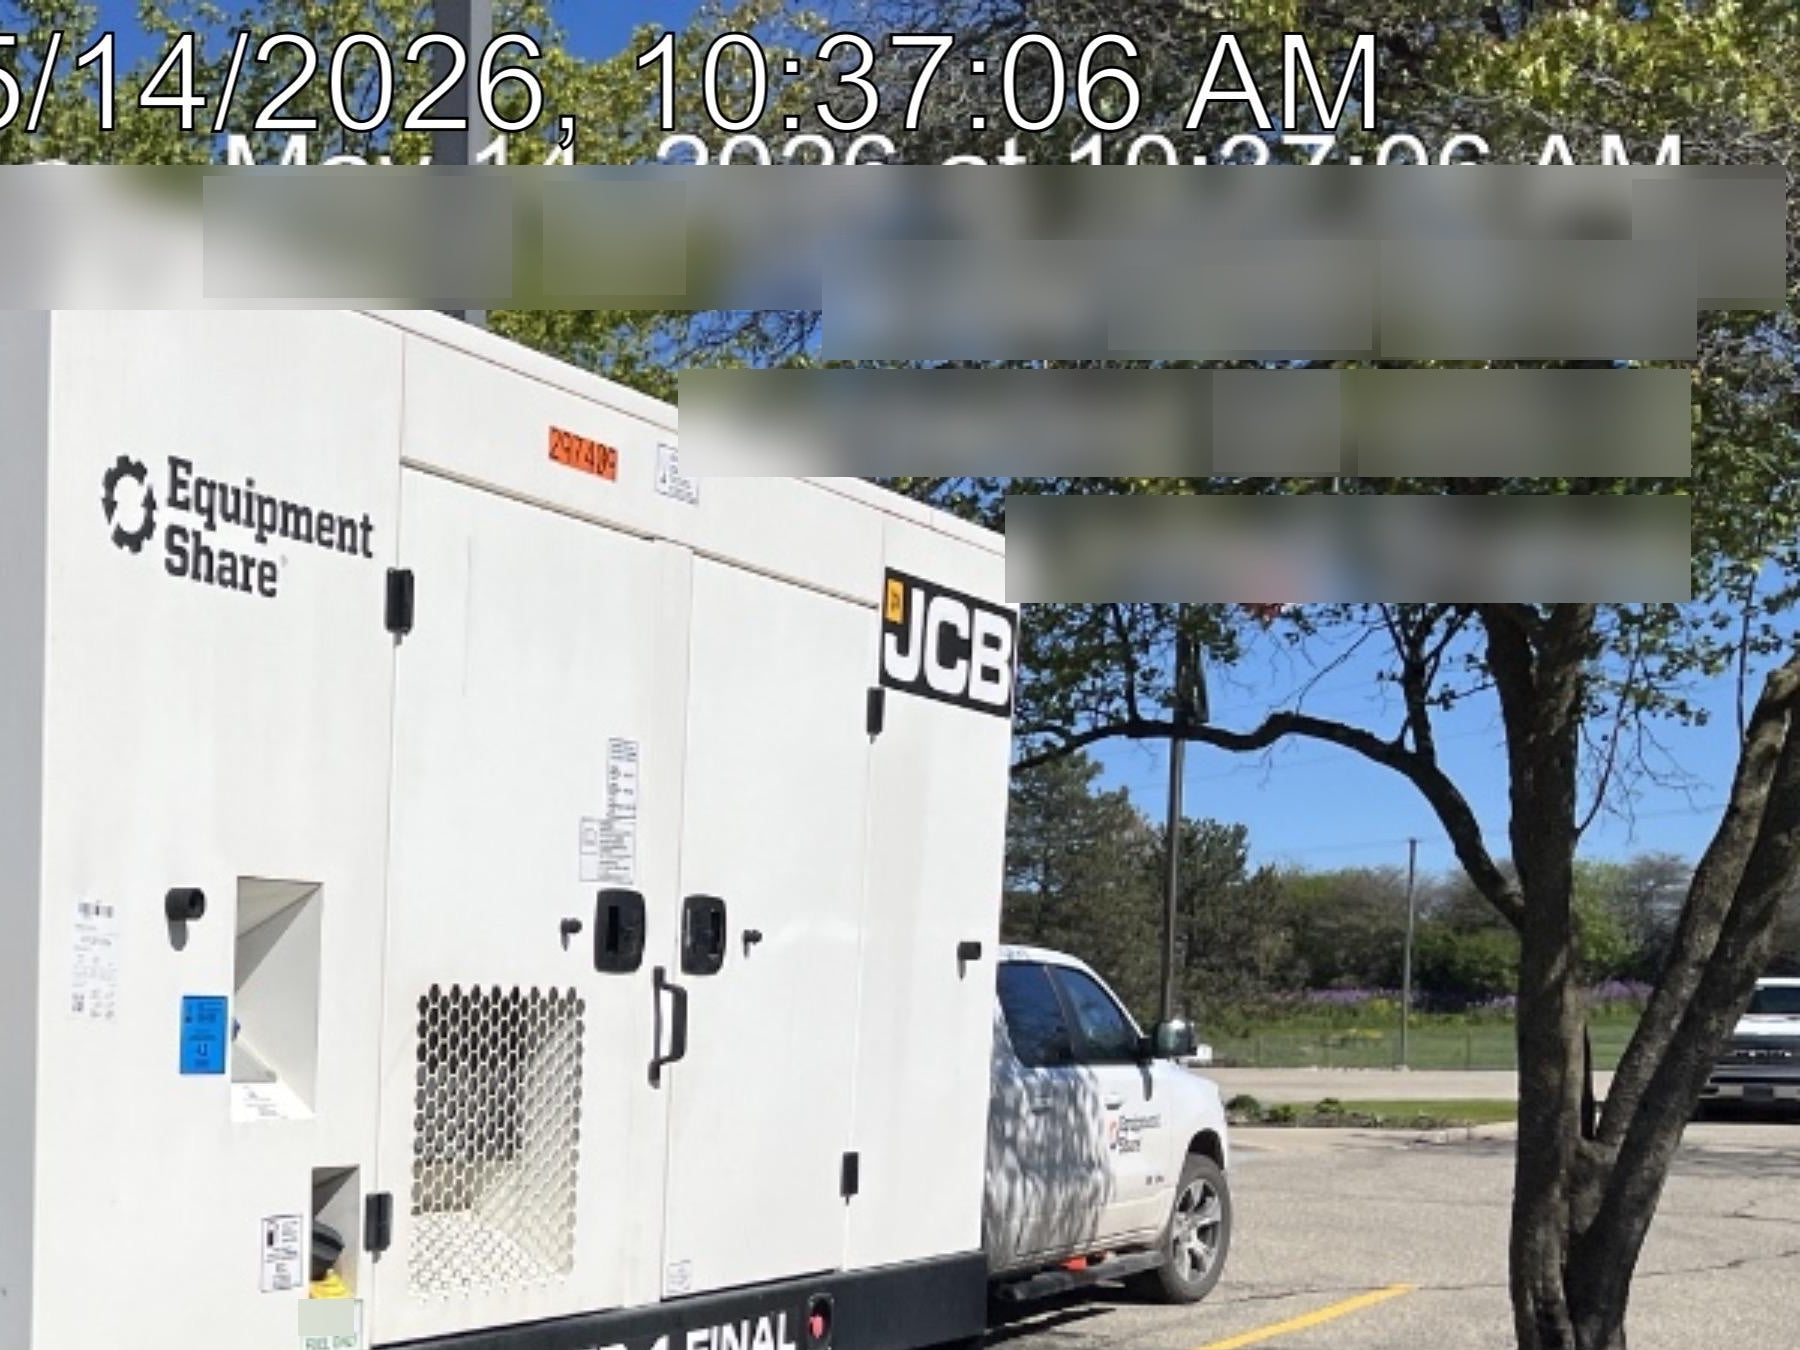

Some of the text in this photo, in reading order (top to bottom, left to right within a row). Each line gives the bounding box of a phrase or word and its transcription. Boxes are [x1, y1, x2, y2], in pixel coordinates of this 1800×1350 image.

[166, 454, 374, 559] Equipment
[163, 523, 278, 599] Share
[883, 586, 1013, 706] JCB
